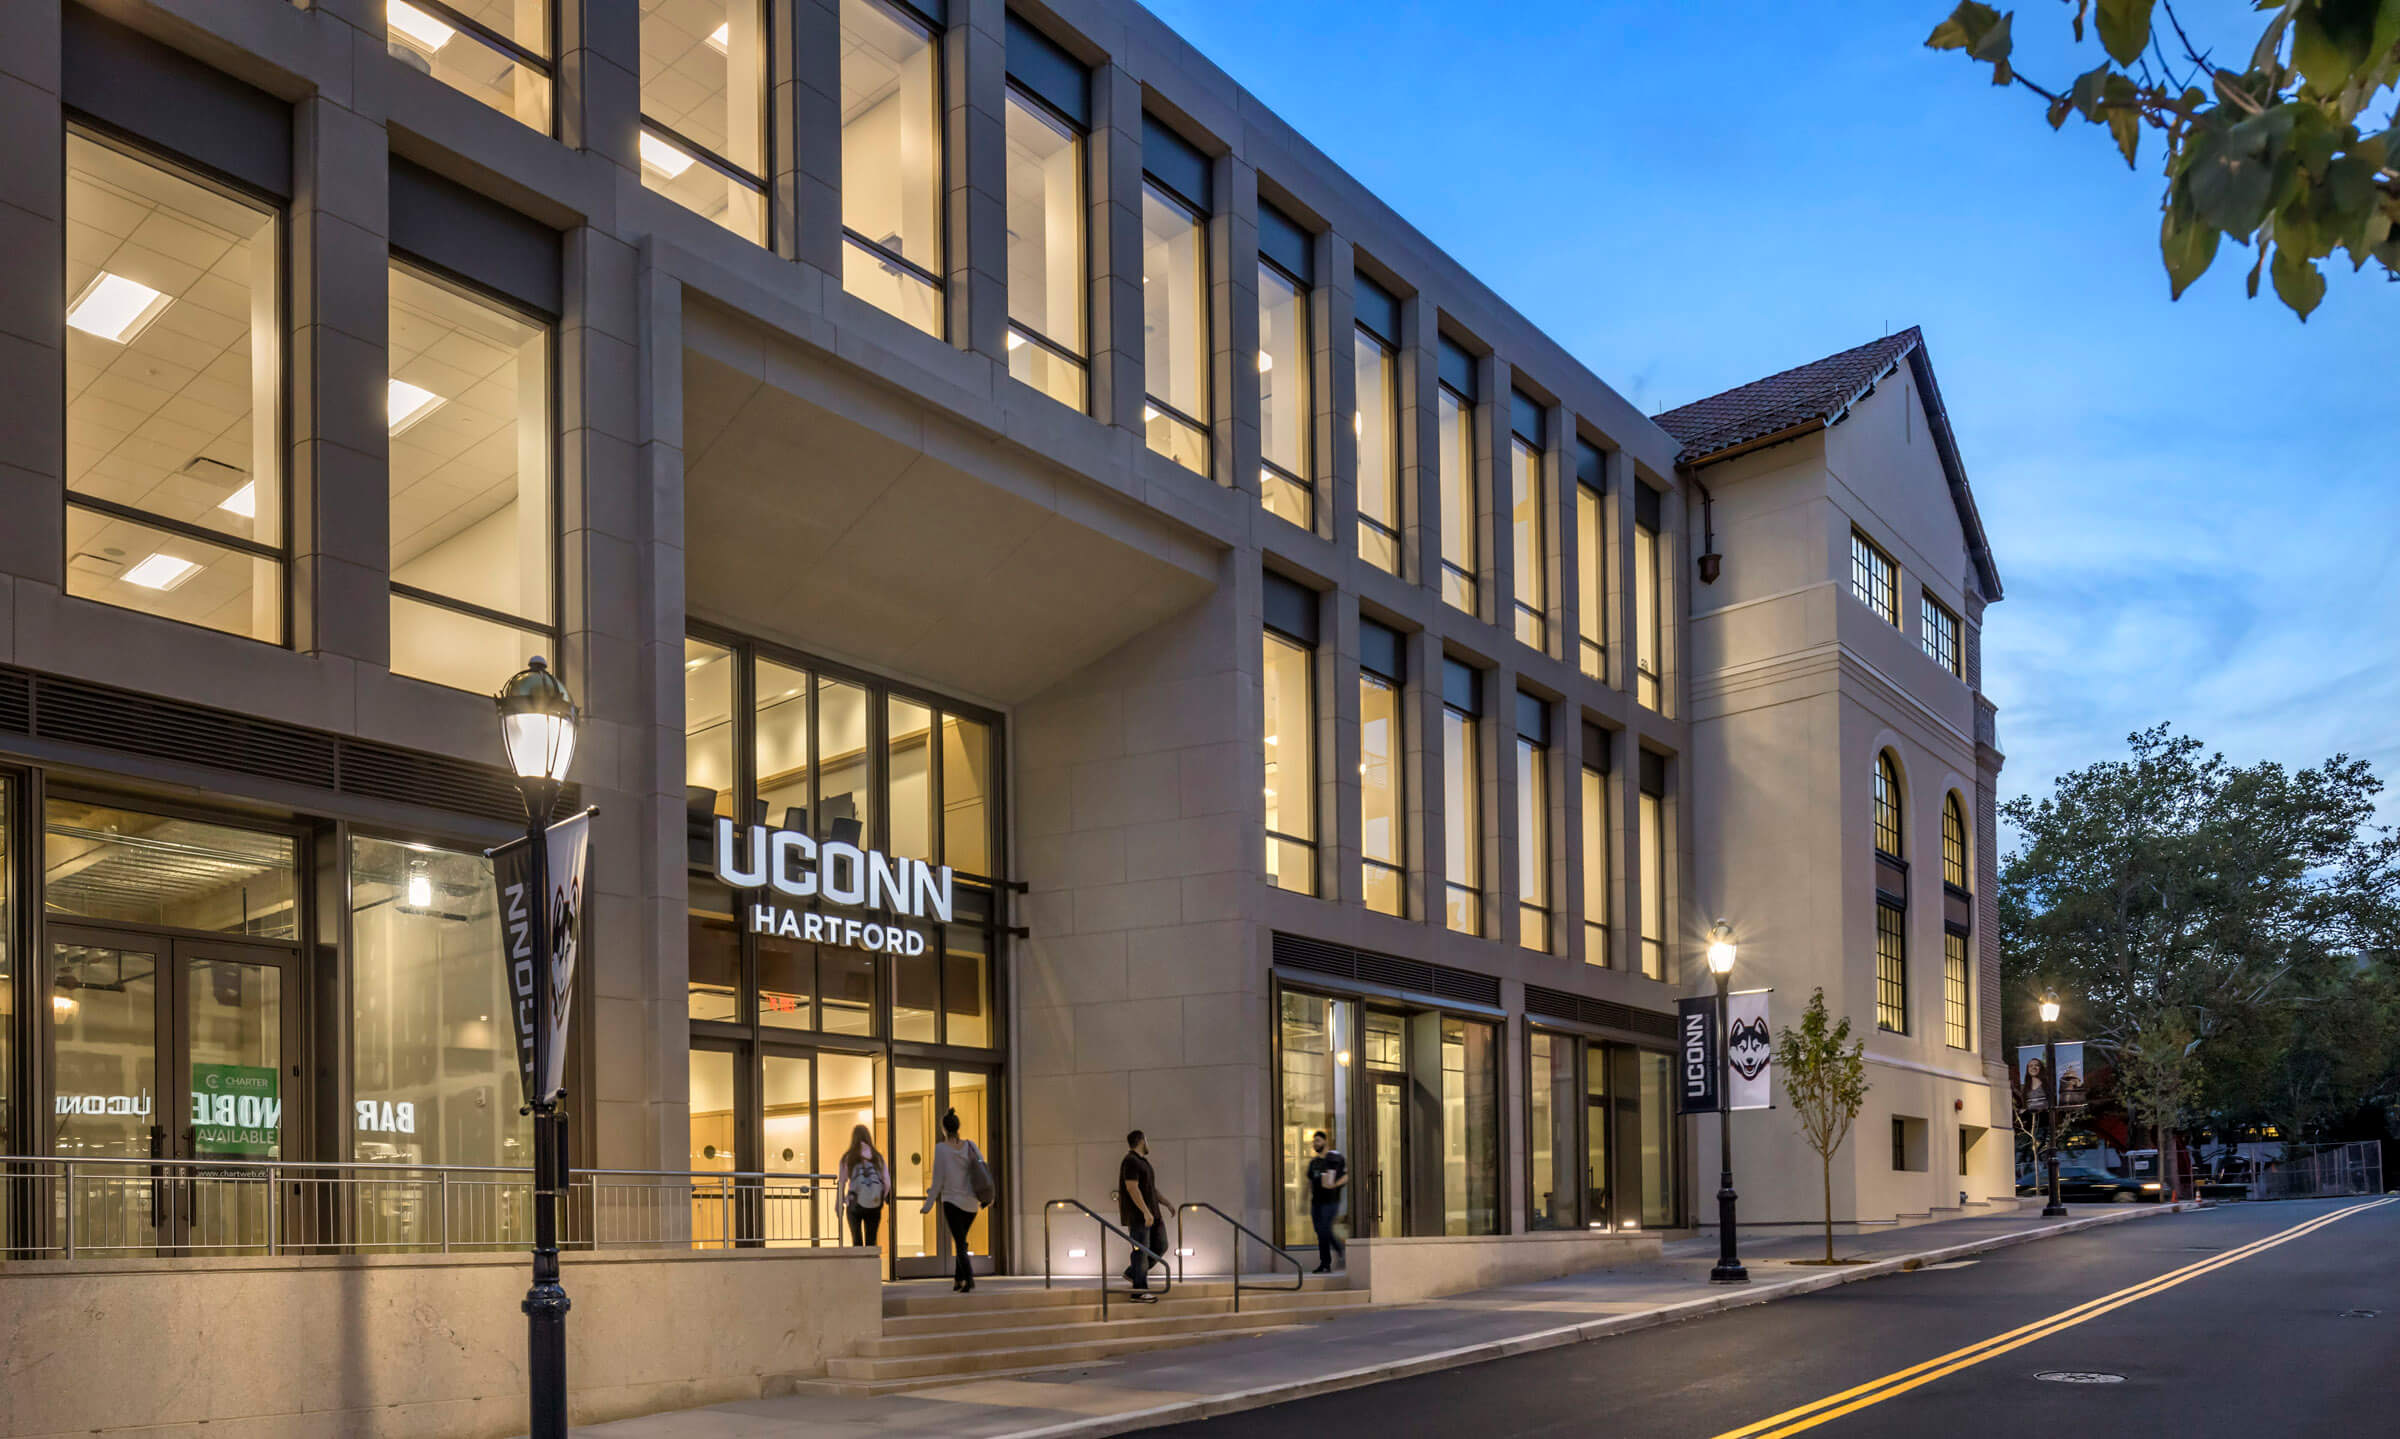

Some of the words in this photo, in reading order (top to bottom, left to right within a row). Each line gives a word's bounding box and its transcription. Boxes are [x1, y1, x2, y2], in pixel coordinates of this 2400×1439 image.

[714, 818, 953, 923] UCONN
[752, 904, 925, 957] HARTFORD
[1686, 1013, 1705, 1097] UCONN
[225, 1076, 268, 1088] CHARTER
[197, 1127, 275, 1145] AVAILABLE
